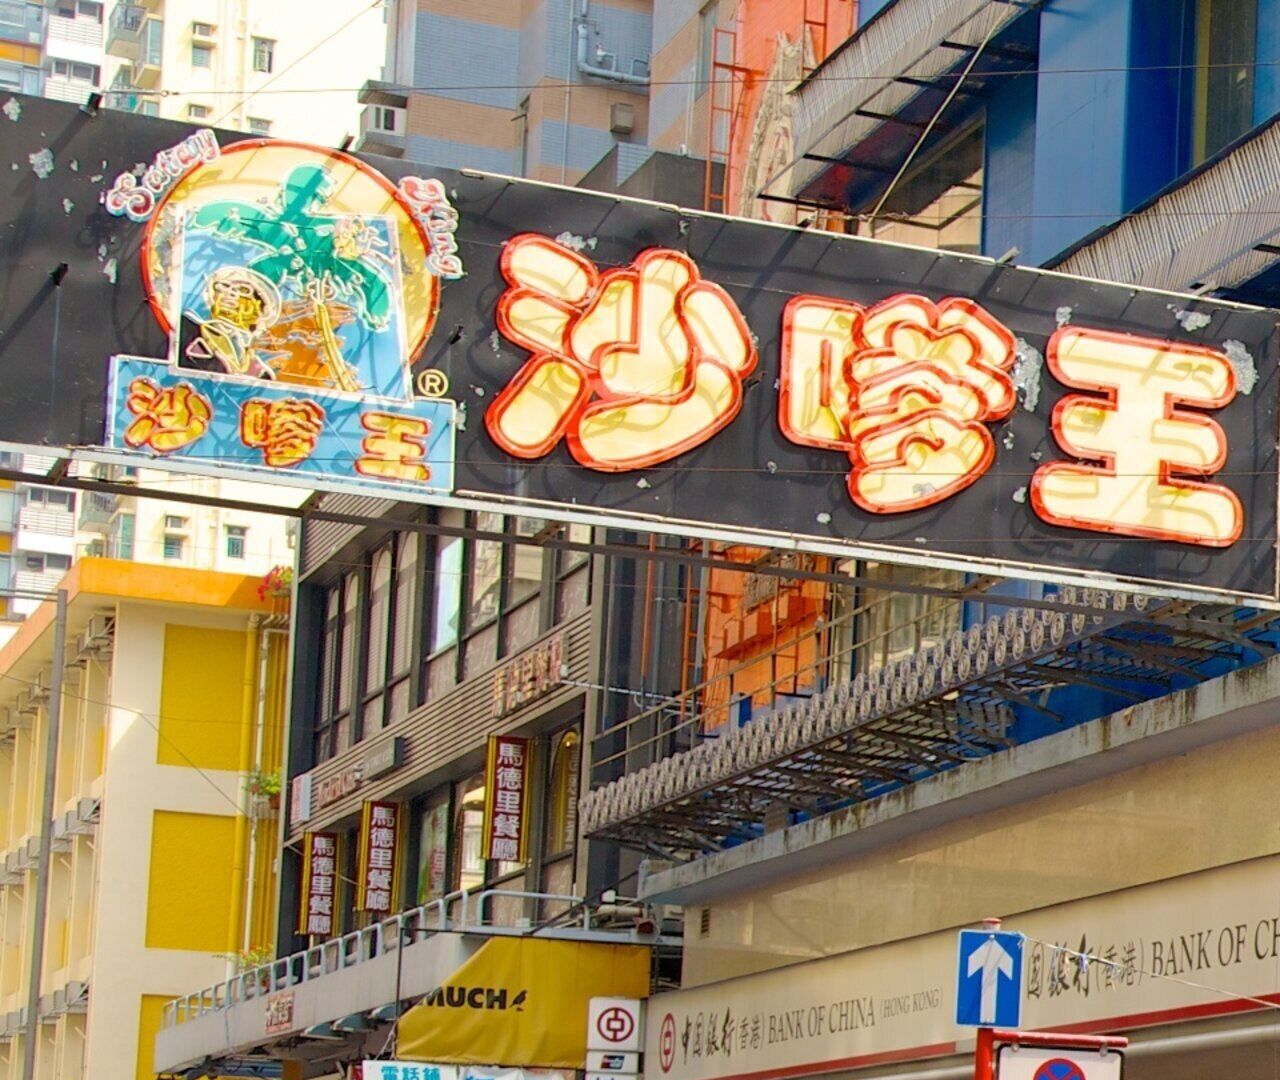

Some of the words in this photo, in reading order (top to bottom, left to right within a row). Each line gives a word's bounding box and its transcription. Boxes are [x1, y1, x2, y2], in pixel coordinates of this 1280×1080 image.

[123, 375, 434, 482] 沙嗲王
[483, 231, 1245, 549] 沙嗲王
[1151, 929, 1213, 977] BANK
[1217, 923, 1249, 967] OF
[768, 1010, 806, 1044] BANK
[807, 1004, 826, 1039] OF
[827, 996, 877, 1033] CHINA
